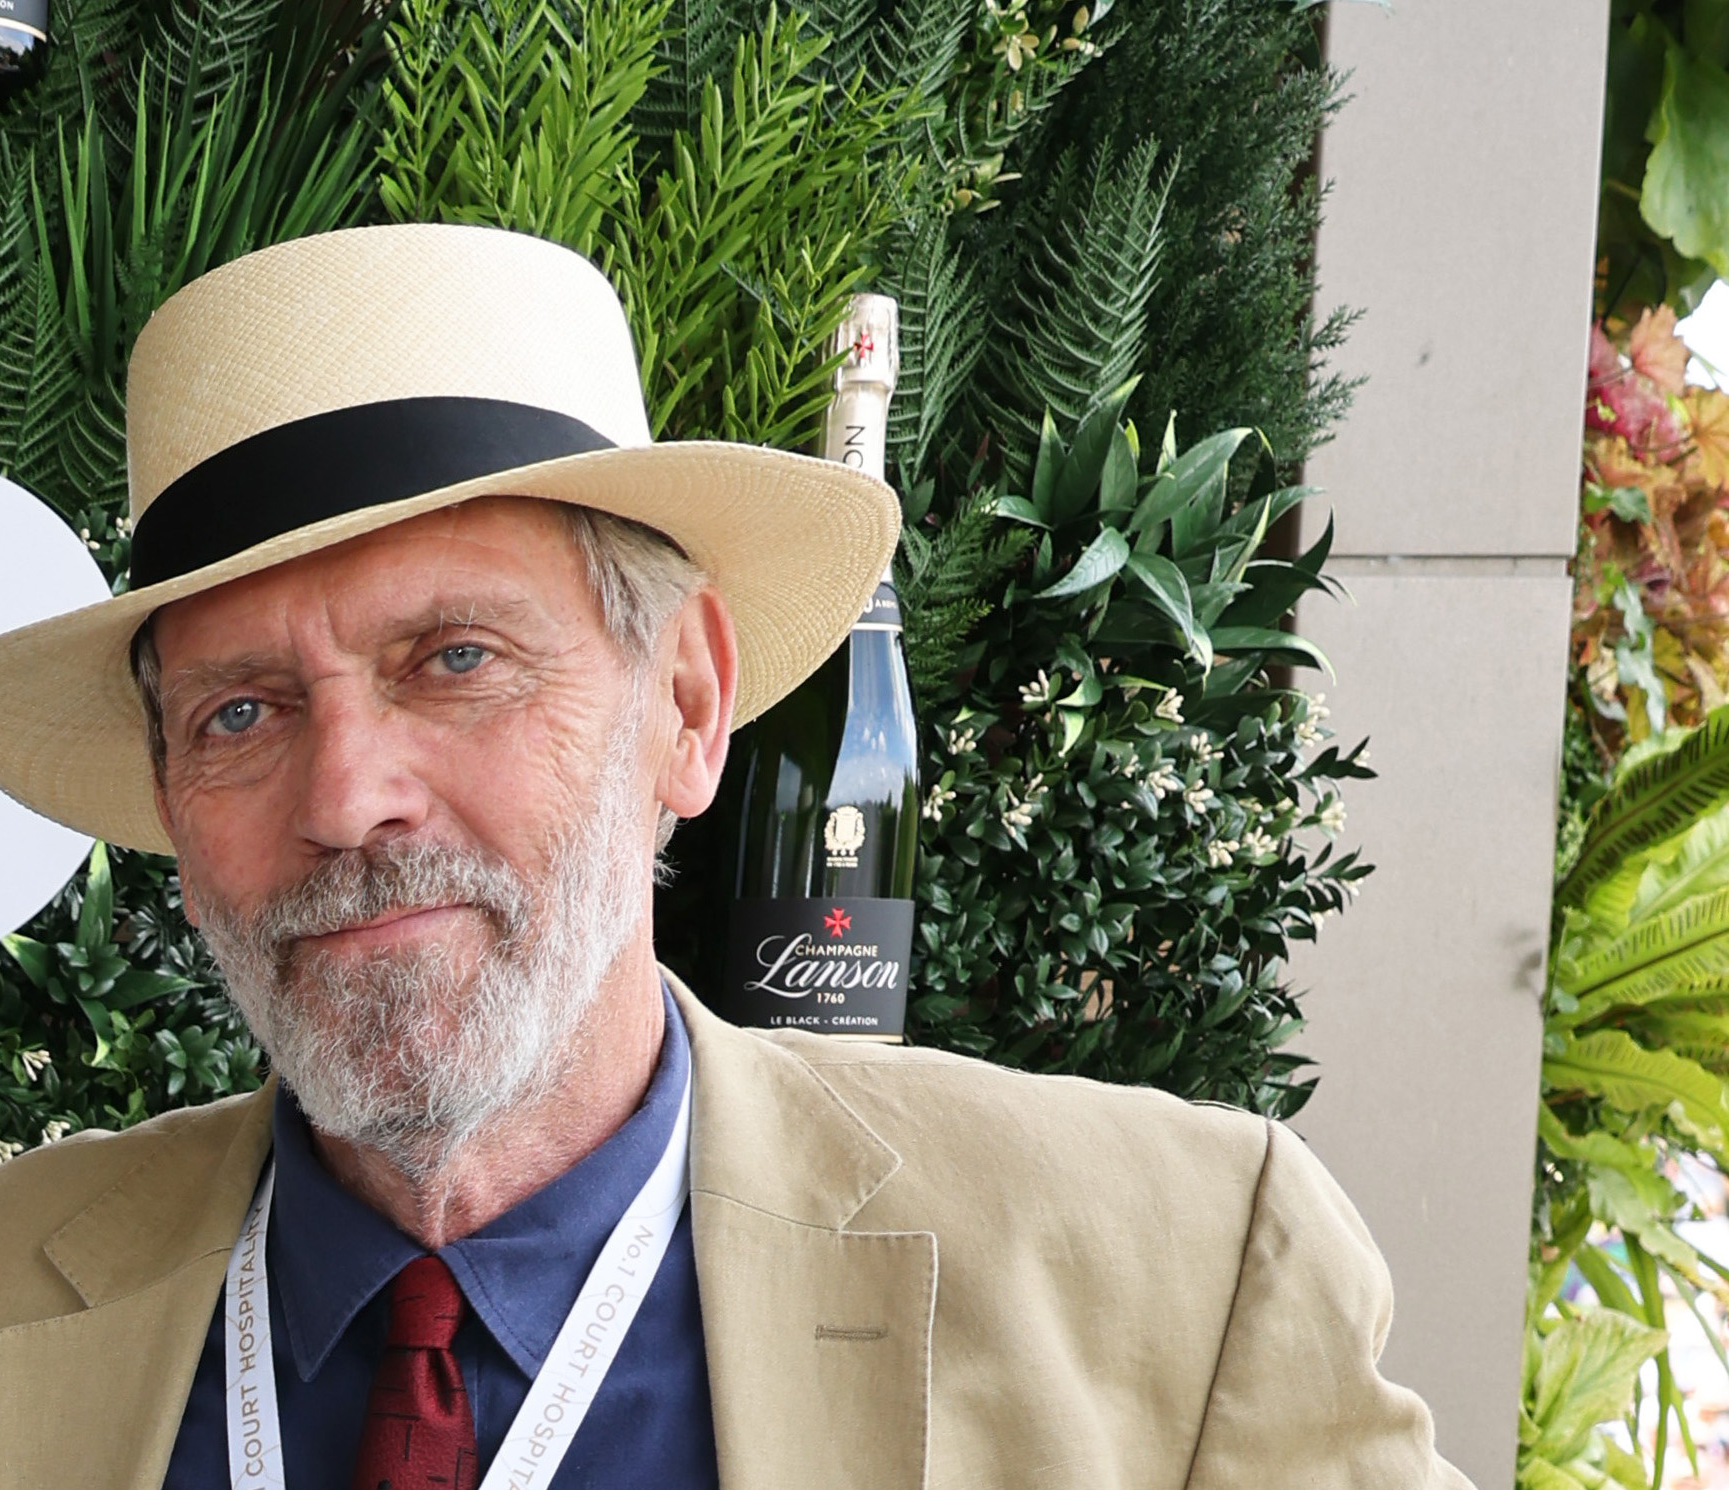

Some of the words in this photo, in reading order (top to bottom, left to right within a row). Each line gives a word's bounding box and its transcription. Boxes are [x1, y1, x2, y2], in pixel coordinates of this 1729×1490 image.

[744, 933, 900, 998] Lanson
[794, 945, 879, 957] CHAMPAGNE
[770, 1016, 782, 1025] LE
[786, 1016, 820, 1025] BLACK
[832, 1015, 879, 1026] CRÉATION
[817, 993, 846, 1004] 1760
[617, 1224, 655, 1279] No.1
[238, 1206, 265, 1373] HOSPITALITY
[568, 1282, 626, 1379] COURT
[241, 1385, 265, 1477] COURT
